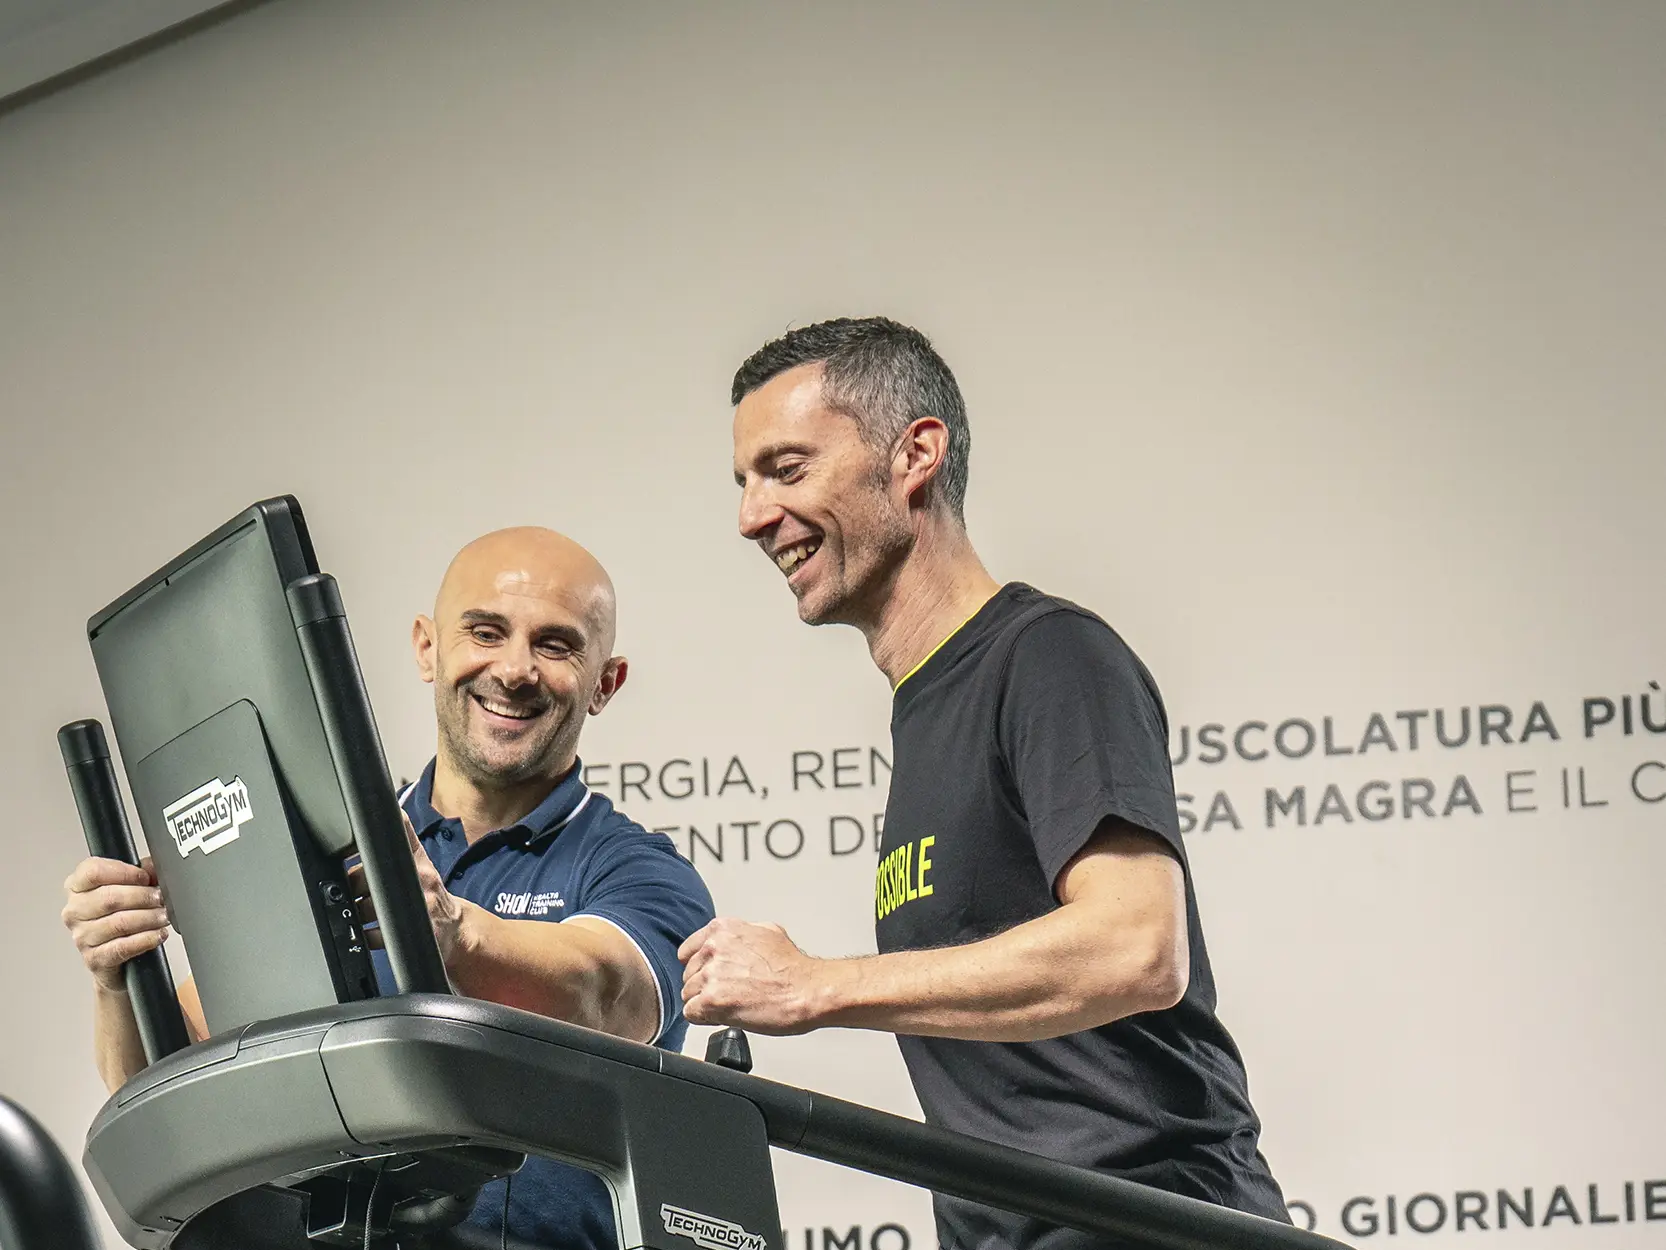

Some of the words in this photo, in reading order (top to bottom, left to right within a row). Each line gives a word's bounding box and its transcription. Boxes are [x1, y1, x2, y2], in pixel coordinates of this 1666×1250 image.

[166, 788, 247, 847] TECHNOGYM
[653, 818, 805, 864] NTO
[1264, 774, 1483, 830] MAGRA
[1506, 770, 1538, 812] E
[1561, 766, 1610, 809] IL
[875, 835, 936, 921] OSSIBLE
[661, 1207, 762, 1250] TECHNOGYM
[1340, 1179, 1666, 1239] GIORNALIE
